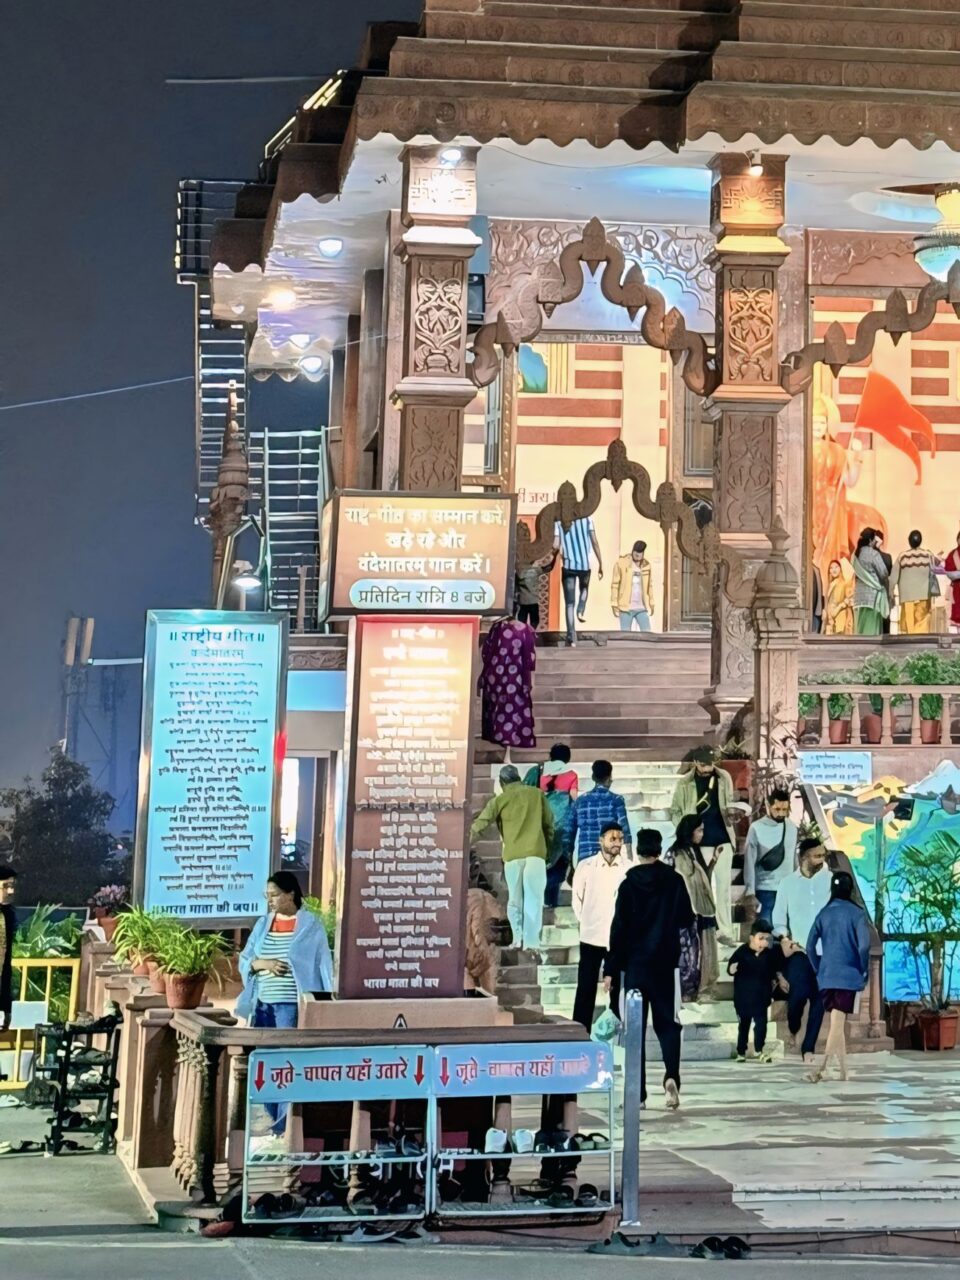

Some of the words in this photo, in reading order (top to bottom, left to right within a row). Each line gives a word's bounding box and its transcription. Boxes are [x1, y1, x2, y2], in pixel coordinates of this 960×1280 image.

[429, 557, 458, 574] गान
[358, 586, 411, 604] प्रतिदिन
[416, 586, 445, 604] रात्रि
[451, 589, 459, 604] 8
[181, 628, 222, 644] राष्ट्रीय
[226, 628, 254, 642] गीत
[190, 903, 214, 914] माता
[217, 900, 230, 913] की
[346, 1058, 372, 1081] यहाँ
[529, 1055, 555, 1078] यहाँ
